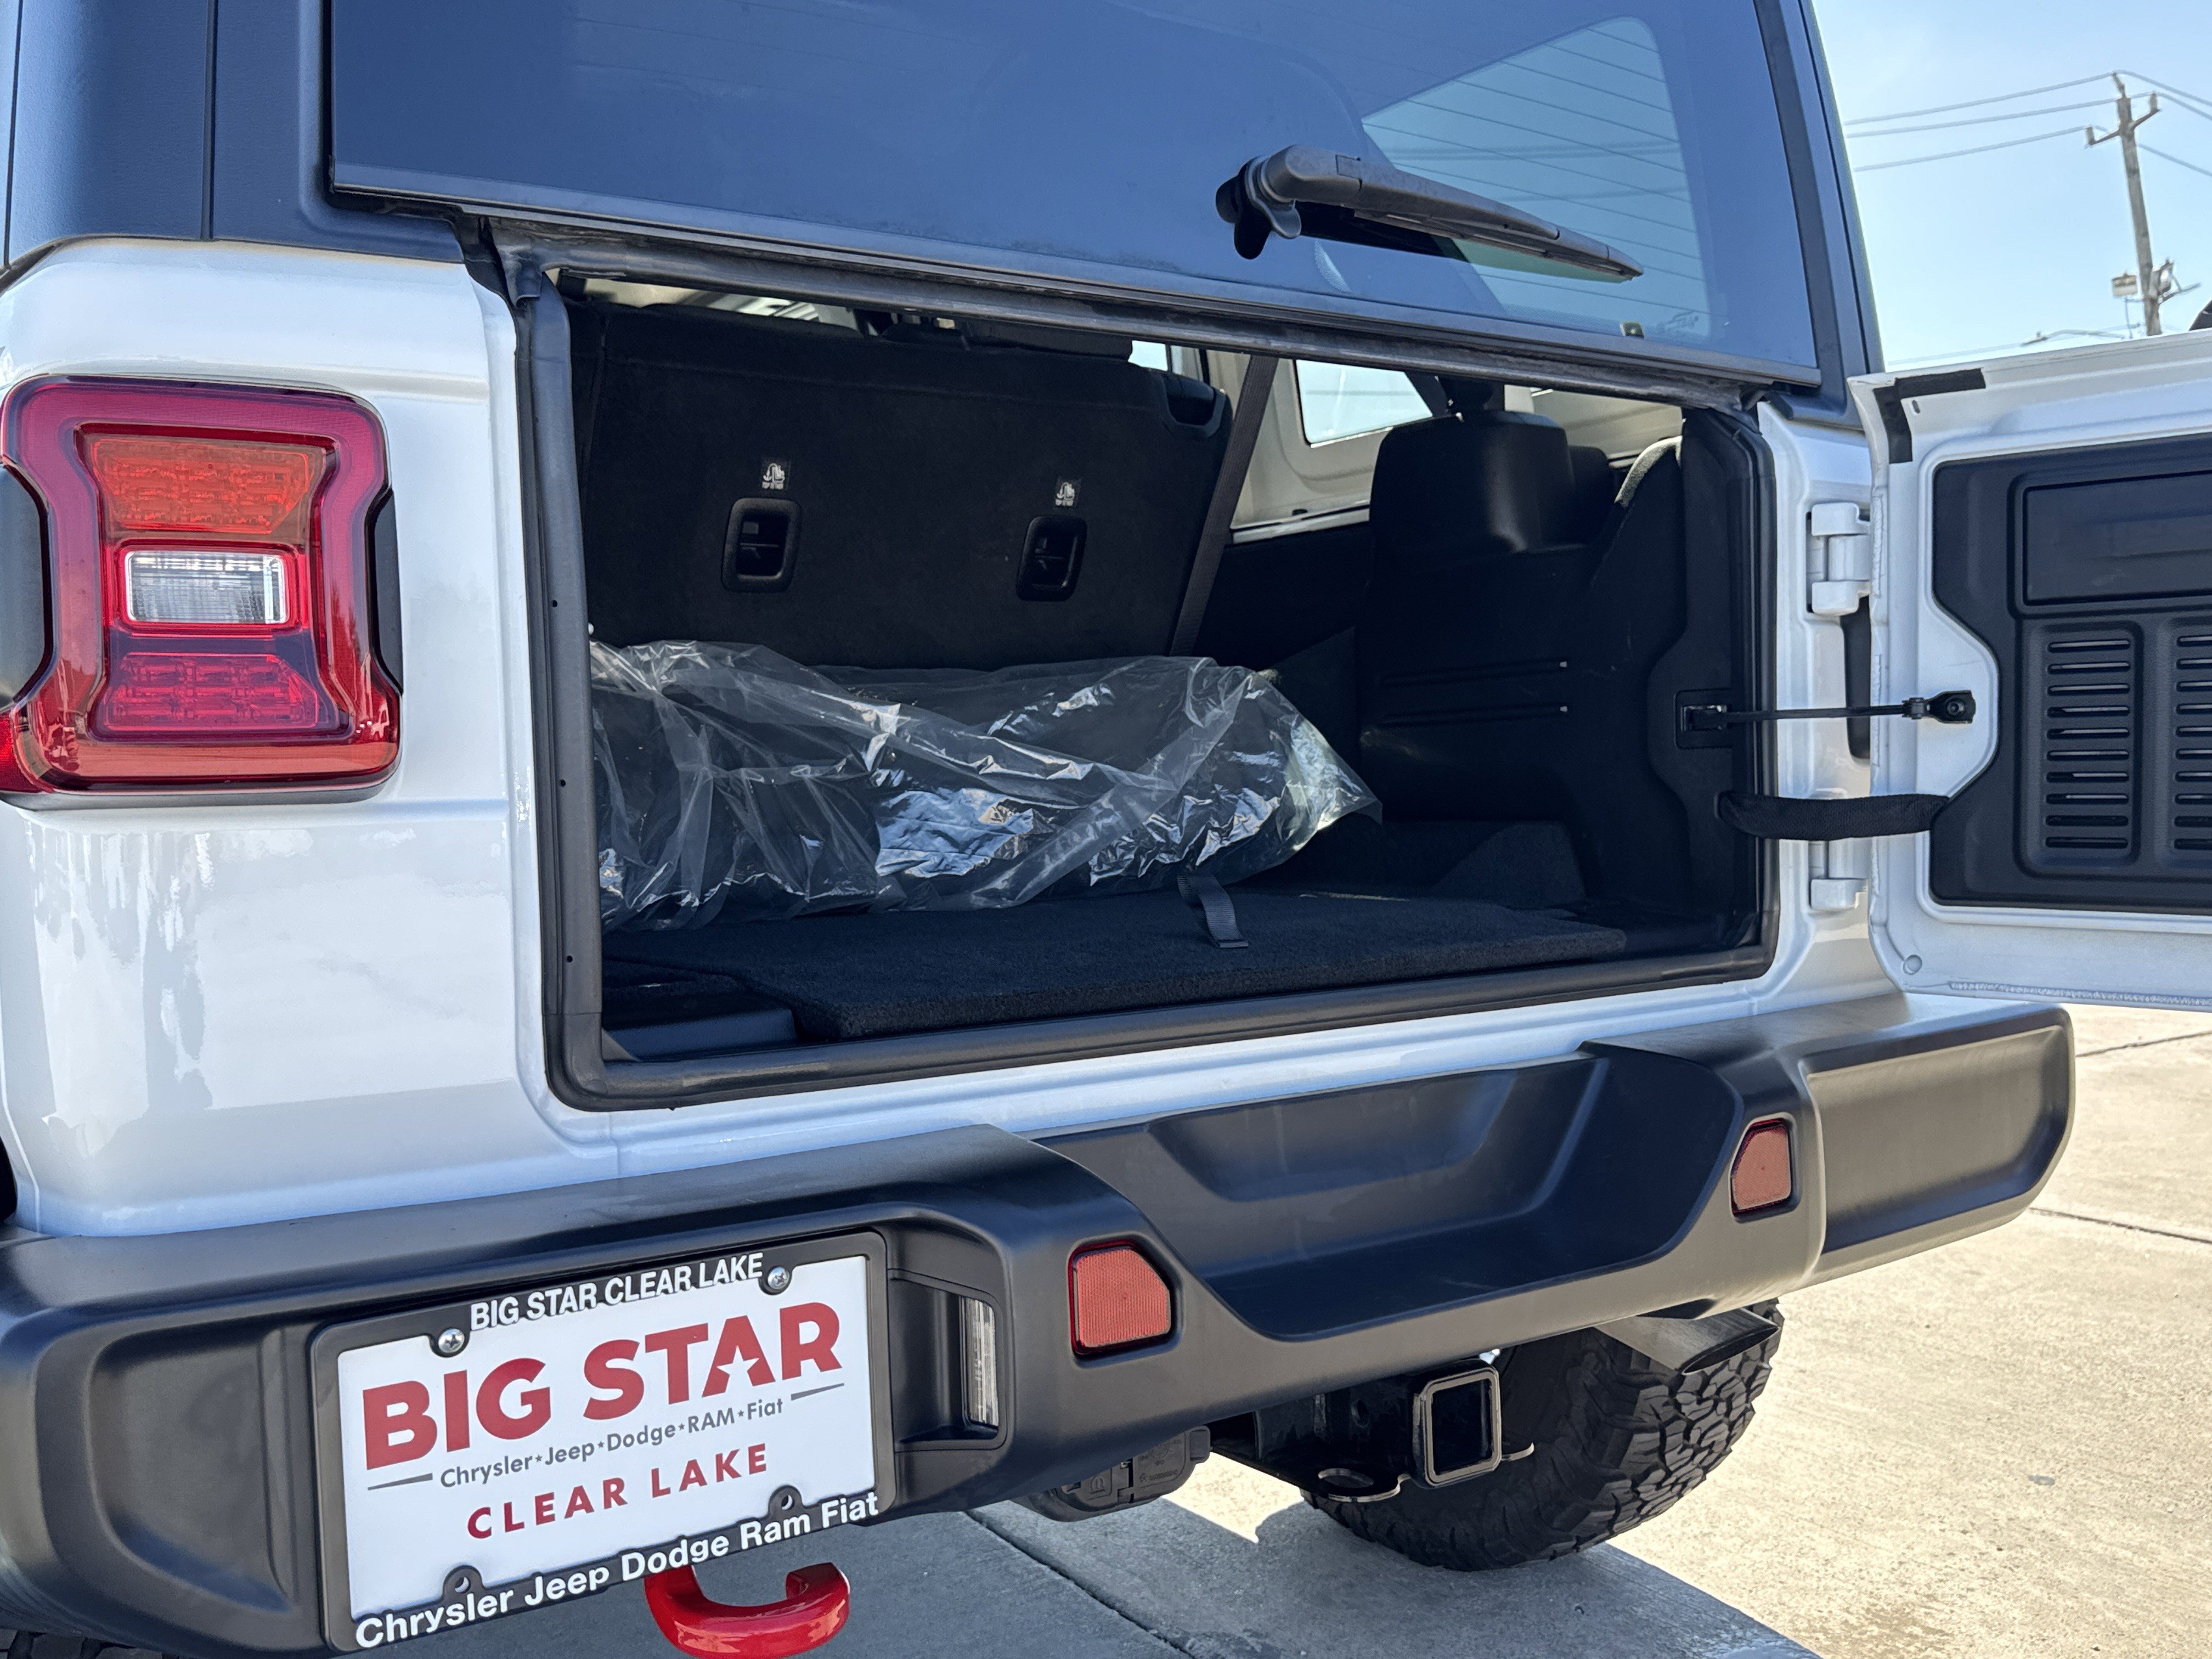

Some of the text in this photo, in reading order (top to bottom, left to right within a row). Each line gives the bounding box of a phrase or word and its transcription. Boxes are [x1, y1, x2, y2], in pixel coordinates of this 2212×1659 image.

[471, 1252, 764, 1330] BIG STAR CLEAR LAKE
[363, 1301, 843, 1471] BIG STAR
[440, 1398, 783, 1488] Chrysler Jeep Dodge RAM Fiat
[467, 1443, 767, 1539] CLEAR LAKE
[356, 1491, 879, 1648] Chrysler Jeep Dodge Ram Fiat
